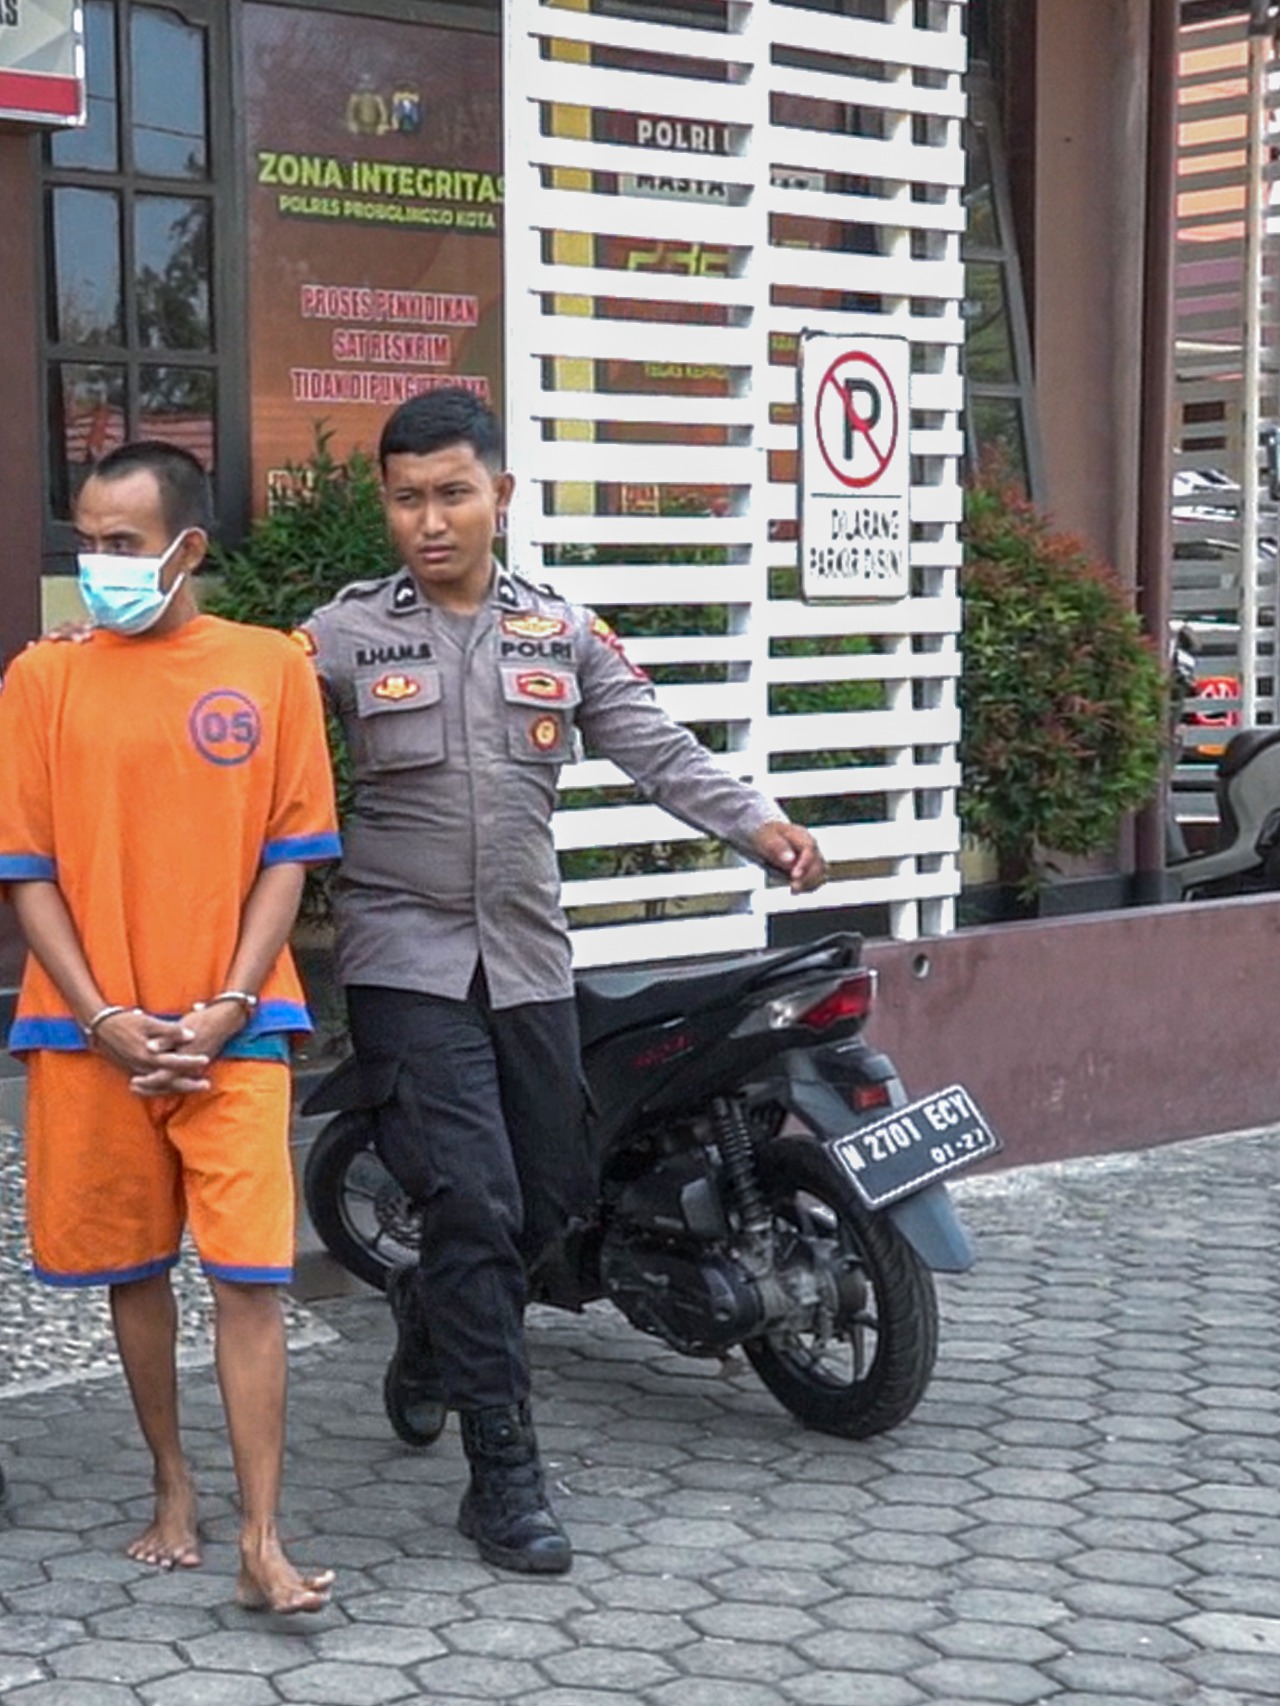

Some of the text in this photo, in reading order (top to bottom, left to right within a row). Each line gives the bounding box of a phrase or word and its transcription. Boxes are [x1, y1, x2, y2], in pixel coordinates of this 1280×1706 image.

[637, 119, 715, 152] POLRI
[257, 152, 344, 189] ZONA
[303, 285, 371, 319] PROSES
[333, 329, 451, 365] SAT RESKRIM
[292, 369, 349, 402] TIDAK
[500, 641, 571, 660] POLRI
[201, 711, 254, 743] 05
[841, 1143, 867, 1172] N
[922, 1093, 971, 1132] ECY
